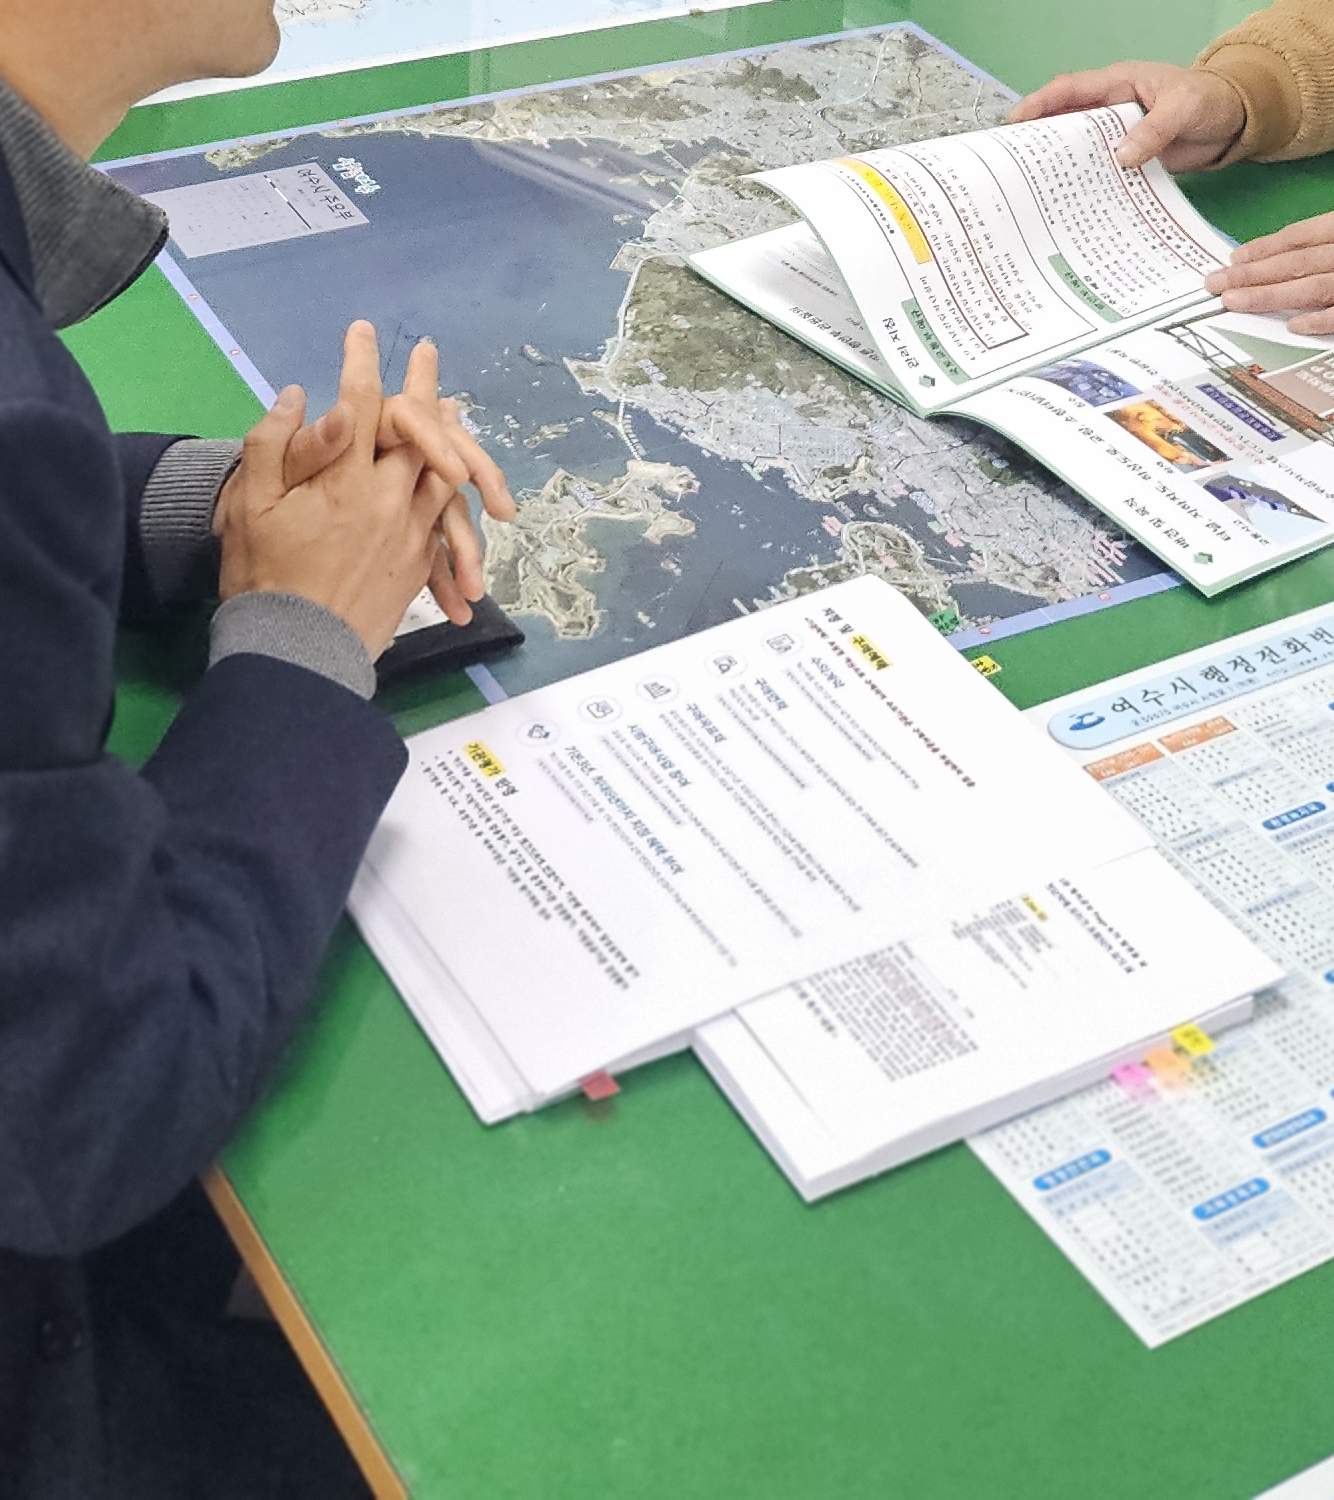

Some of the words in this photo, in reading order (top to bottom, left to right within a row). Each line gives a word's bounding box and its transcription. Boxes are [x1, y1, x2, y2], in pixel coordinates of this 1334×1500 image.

[880, 314, 902, 343] 지침
[896, 342, 919, 370] 관리
[1122, 493, 1150, 519] 목적
[1148, 514, 1163, 528] 및
[1162, 524, 1190, 550] 배경
[821, 605, 843, 624] 지정
[849, 633, 890, 672] 구매혜택
[465, 741, 501, 779] 기관평가
[493, 775, 519, 800] 반영
